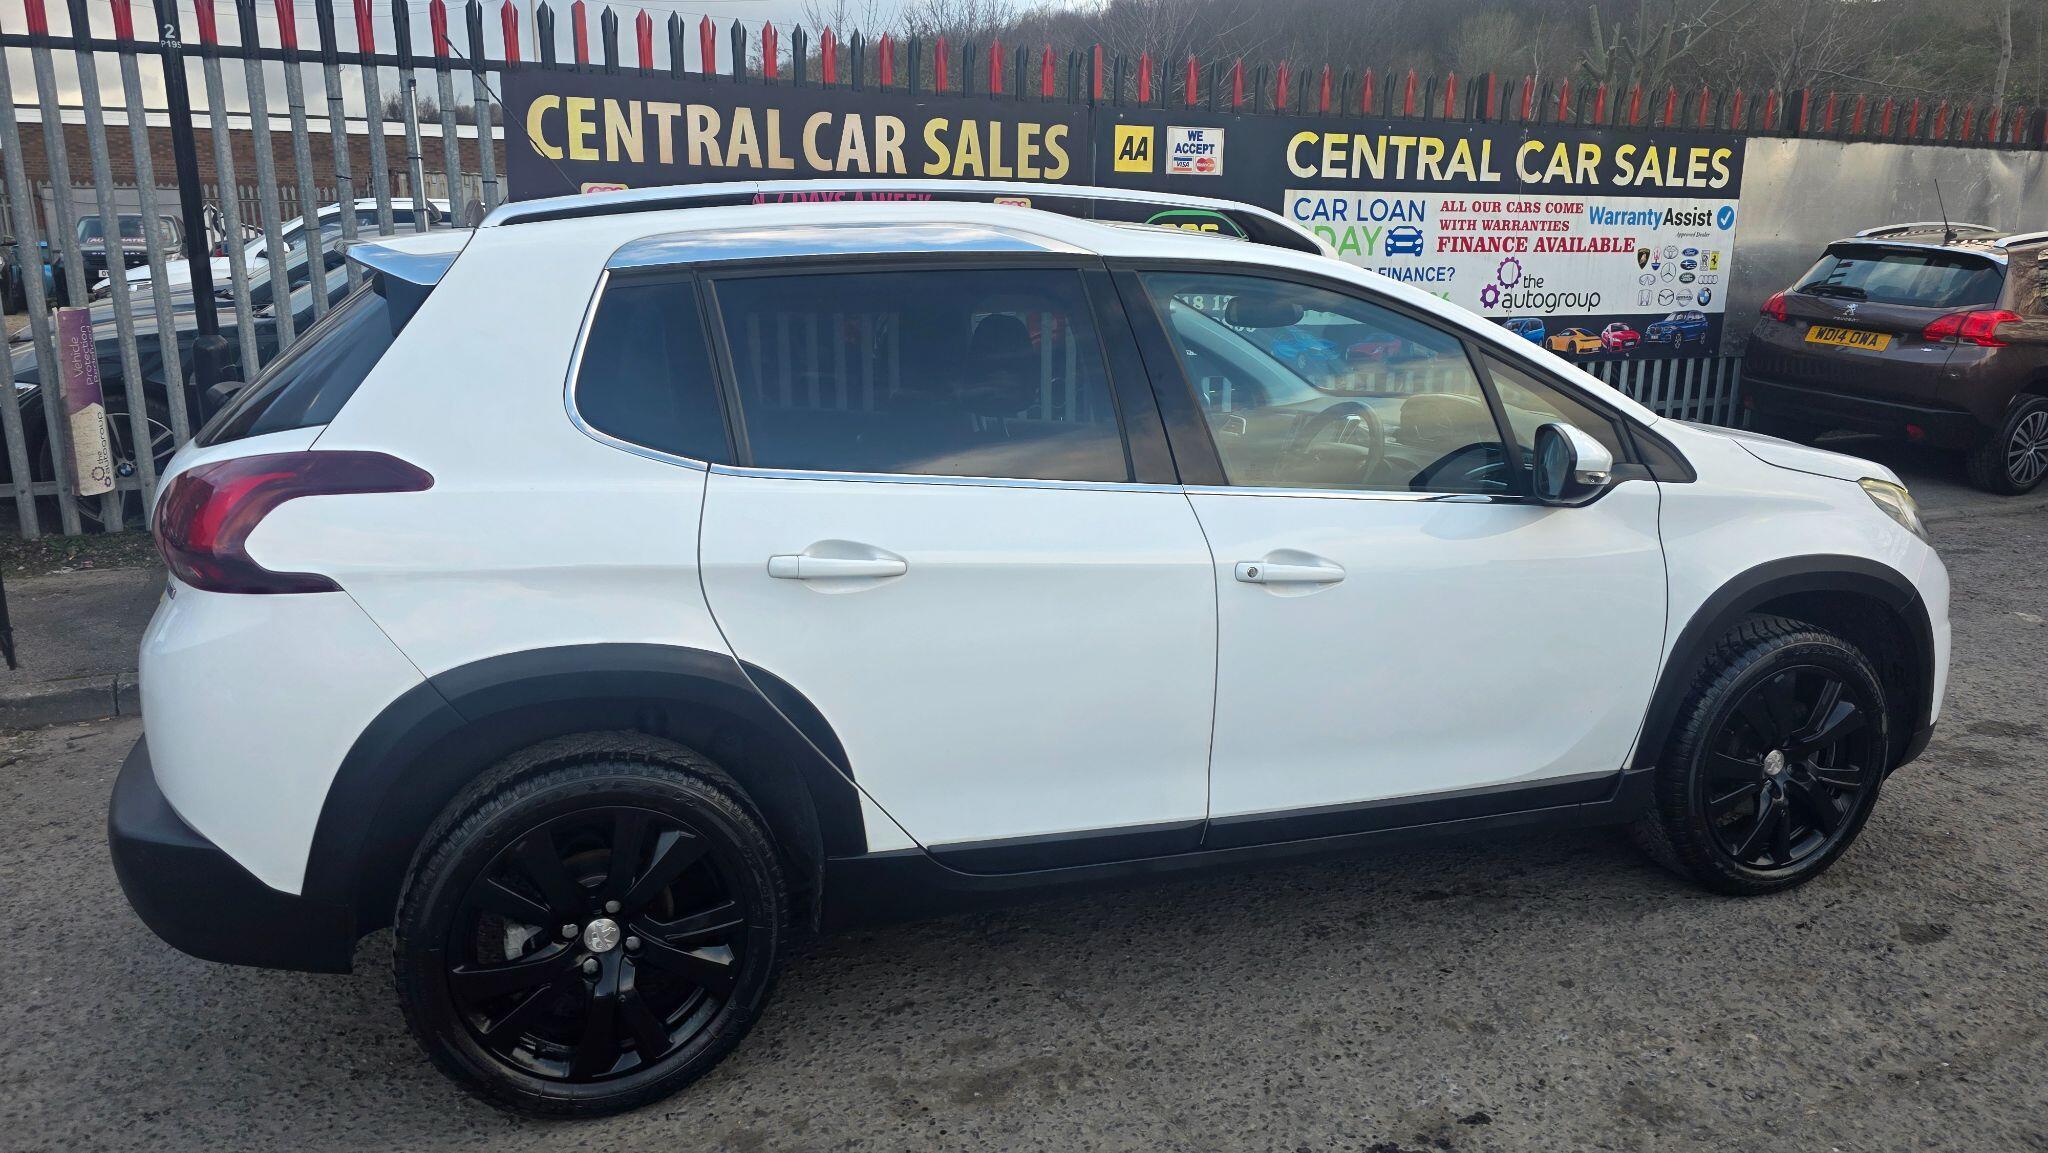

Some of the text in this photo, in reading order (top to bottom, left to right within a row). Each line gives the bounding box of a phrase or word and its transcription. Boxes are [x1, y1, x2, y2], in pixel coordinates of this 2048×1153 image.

[164, 24, 176, 39] 2
[526, 94, 1070, 180] CENTRAL CAR SALES
[1188, 130, 1204, 142] WE
[1118, 136, 1148, 160] AA
[1174, 142, 1215, 155] ACCEPT
[1286, 131, 1732, 189] CENTRAL CAR SALES
[1293, 197, 1426, 222] CAR LOAN
[1440, 200, 1584, 214] ALL OUR CARS COME
[1439, 219, 1570, 232] WITH WARRANTIES
[1302, 225, 1383, 256] DAY
[1437, 236, 1636, 253] FINANCE AVAILABLE
[1523, 273, 1544, 289] the
[1501, 290, 1600, 313] autogroup
[1814, 327, 1879, 346] WD14 OWA
[69, 336, 84, 378] Vehicle
[81, 325, 95, 386] Protection
[97, 411, 111, 475] autogroup
